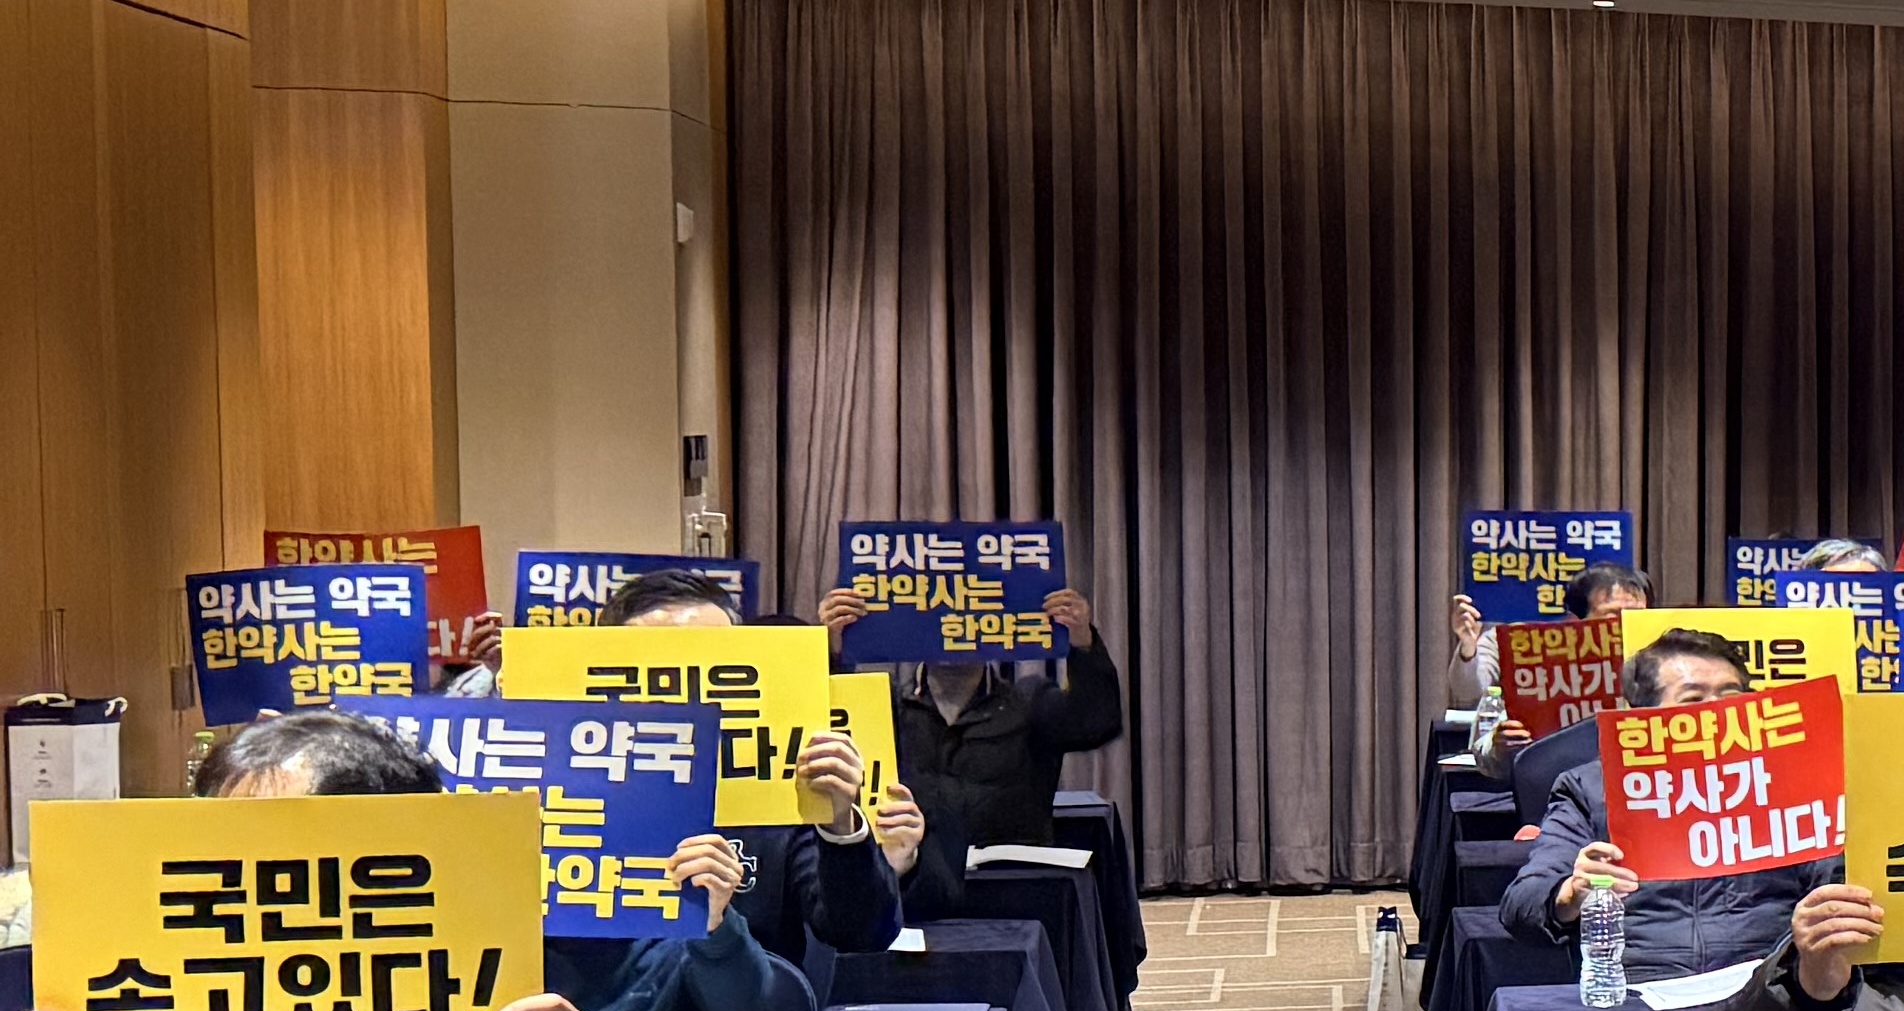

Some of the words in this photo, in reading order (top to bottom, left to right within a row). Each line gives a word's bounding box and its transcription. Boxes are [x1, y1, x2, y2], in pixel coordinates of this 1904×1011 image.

[850, 533, 965, 571] 약사는
[977, 534, 1050, 571] 약국
[1471, 519, 1557, 550] 약사는
[1566, 520, 1622, 550] 약국
[1471, 551, 1586, 582] 한약사는
[199, 579, 316, 623] 약사는
[328, 576, 411, 617] 약국
[852, 573, 1004, 611] 한약사는
[202, 621, 361, 669] 한약사는
[940, 614, 1053, 651] 한약국
[289, 662, 413, 705] 한약국
[1514, 660, 1616, 701] 약사가
[366, 716, 546, 779] 사는
[570, 721, 695, 783] 약국
[1616, 697, 1806, 767] 한약사는
[1622, 756, 1772, 819] 약사가
[1688, 794, 1846, 868] 아니다!
[159, 855, 435, 943] 국민은
[540, 853, 682, 919] 약국
